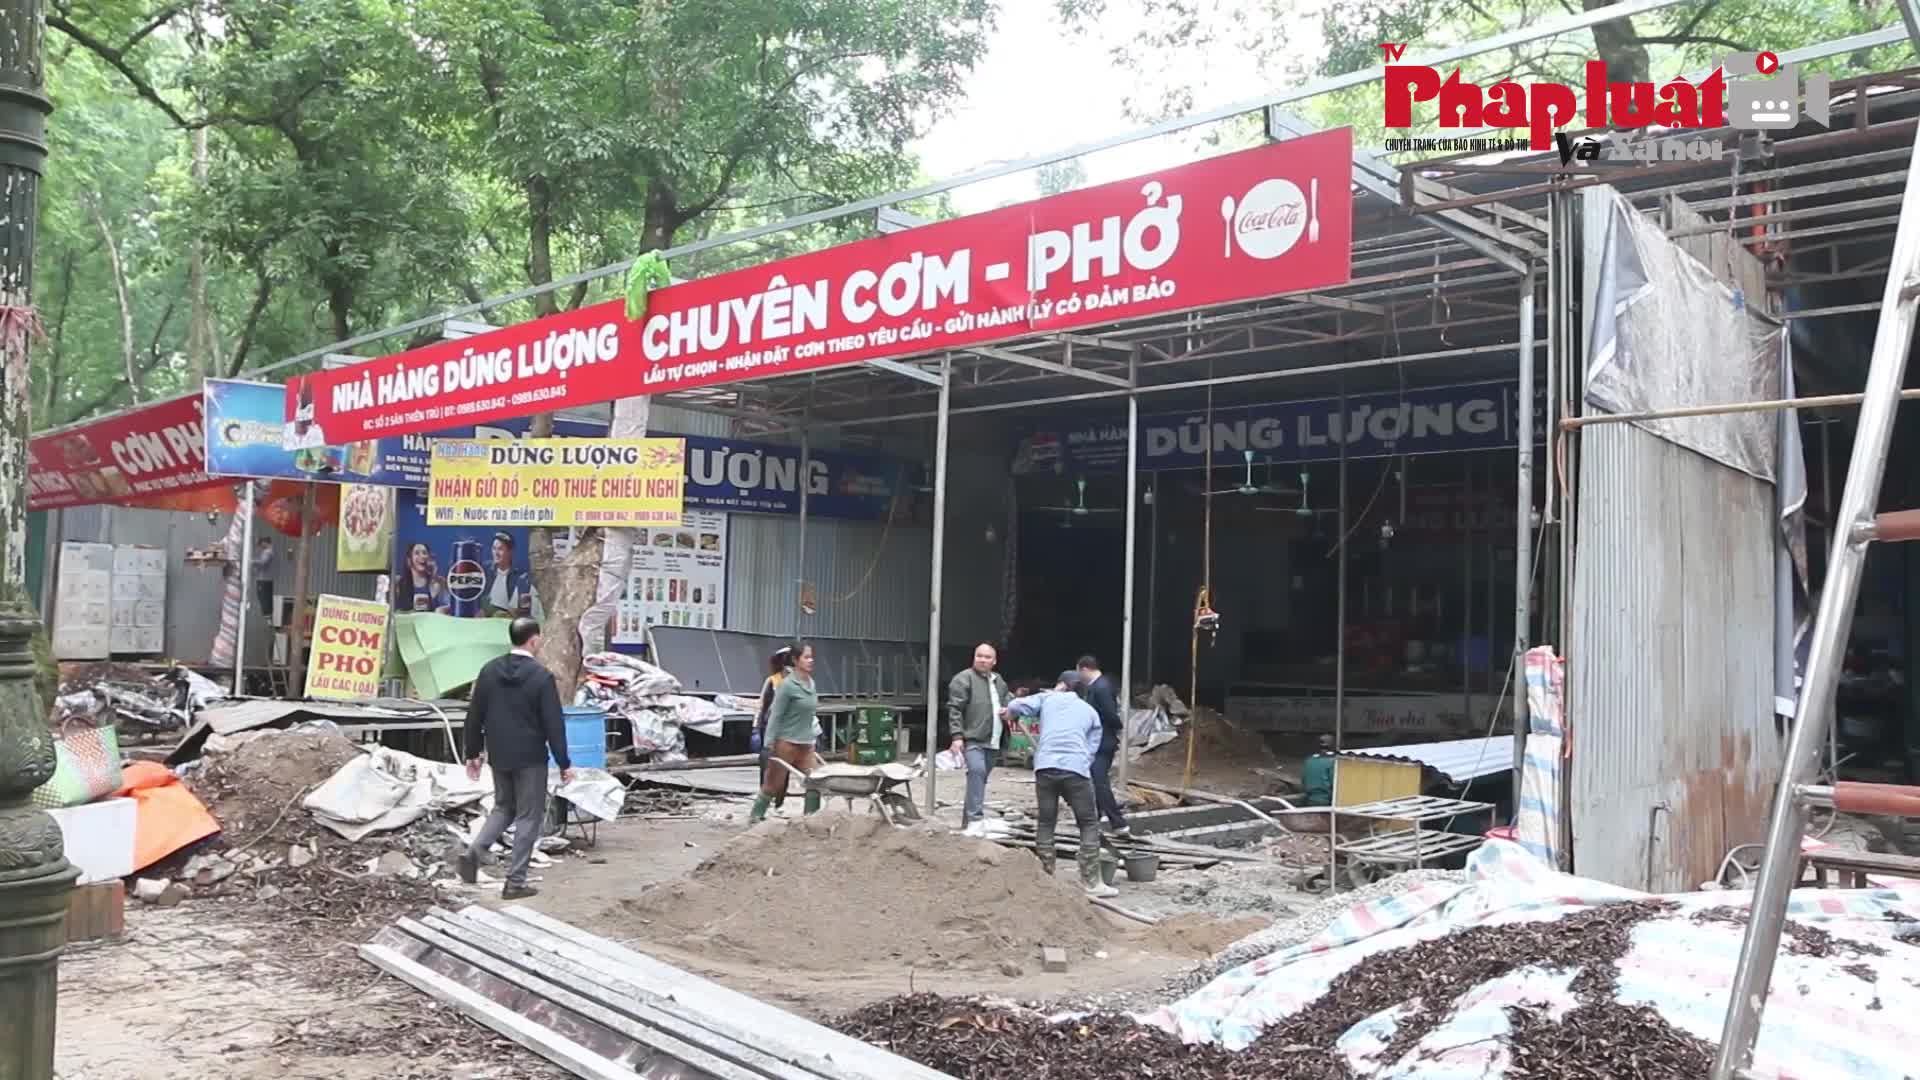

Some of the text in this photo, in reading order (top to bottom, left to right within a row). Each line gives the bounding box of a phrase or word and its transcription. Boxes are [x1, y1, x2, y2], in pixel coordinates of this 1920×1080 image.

[642, 275, 828, 361] CHUYÊN
[841, 249, 971, 324] CƠM
[1026, 181, 1183, 292] PHỞ
[667, 363, 683, 382] TỰ
[684, 360, 717, 378] CHỌN
[725, 351, 761, 371] NHẬN
[763, 345, 789, 366] ĐẶT
[794, 340, 824, 358] CƠM
[827, 335, 865, 352] THEO
[867, 325, 897, 346] YÊU
[900, 318, 932, 341] CẦU
[944, 310, 974, 334] GỬI
[976, 306, 1025, 328] HÀNH
[1055, 292, 1081, 315] CÓ
[1085, 284, 1128, 310] ĐẢM
[1132, 275, 1176, 302] BẢO
[332, 323, 619, 413] NHÀ HÀNG DŨNG LƯỢNG
[111, 431, 176, 475] CƠM
[162, 400, 205, 464] PH
[1146, 414, 1283, 457] DŨNG
[1298, 400, 1499, 449] LƯỢNG
[491, 442, 554, 465] DŨNG
[561, 445, 639, 470] LƯỢNG
[684, 446, 830, 496] ƯỢNG
[435, 474, 472, 502] NHẬN
[533, 478, 560, 498] CHO
[564, 474, 597, 498] THUÊ
[601, 471, 642, 498] CHIẾU
[450, 575, 482, 585] PEPSI
[322, 606, 349, 622] DŨNG
[320, 625, 380, 650] CƠM
[318, 650, 376, 675] PHỞ
